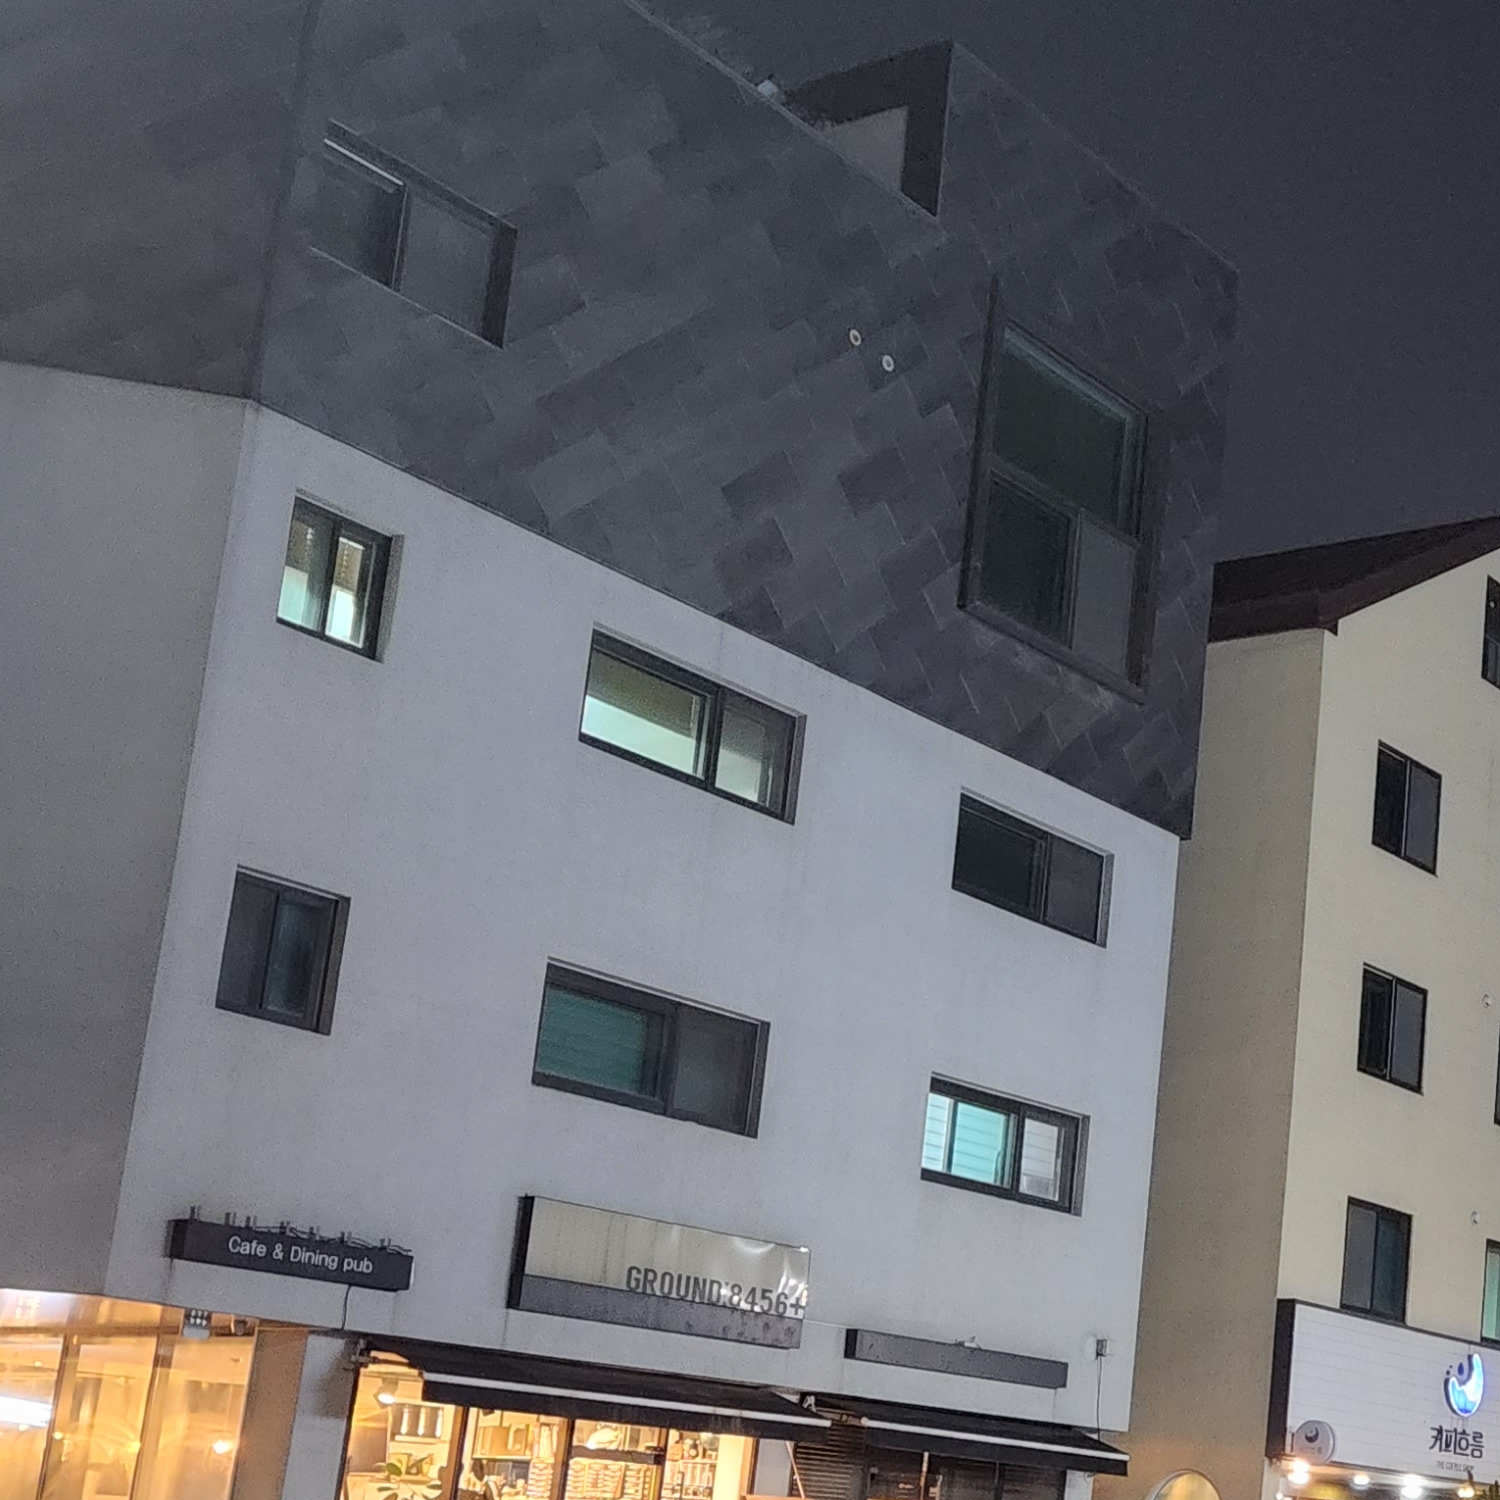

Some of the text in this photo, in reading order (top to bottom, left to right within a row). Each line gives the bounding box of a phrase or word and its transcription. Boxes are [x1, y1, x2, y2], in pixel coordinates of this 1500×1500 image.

[228, 1235, 374, 1274] Cafe & Dining pub
[1428, 1424, 1485, 1459] 커피흐름
